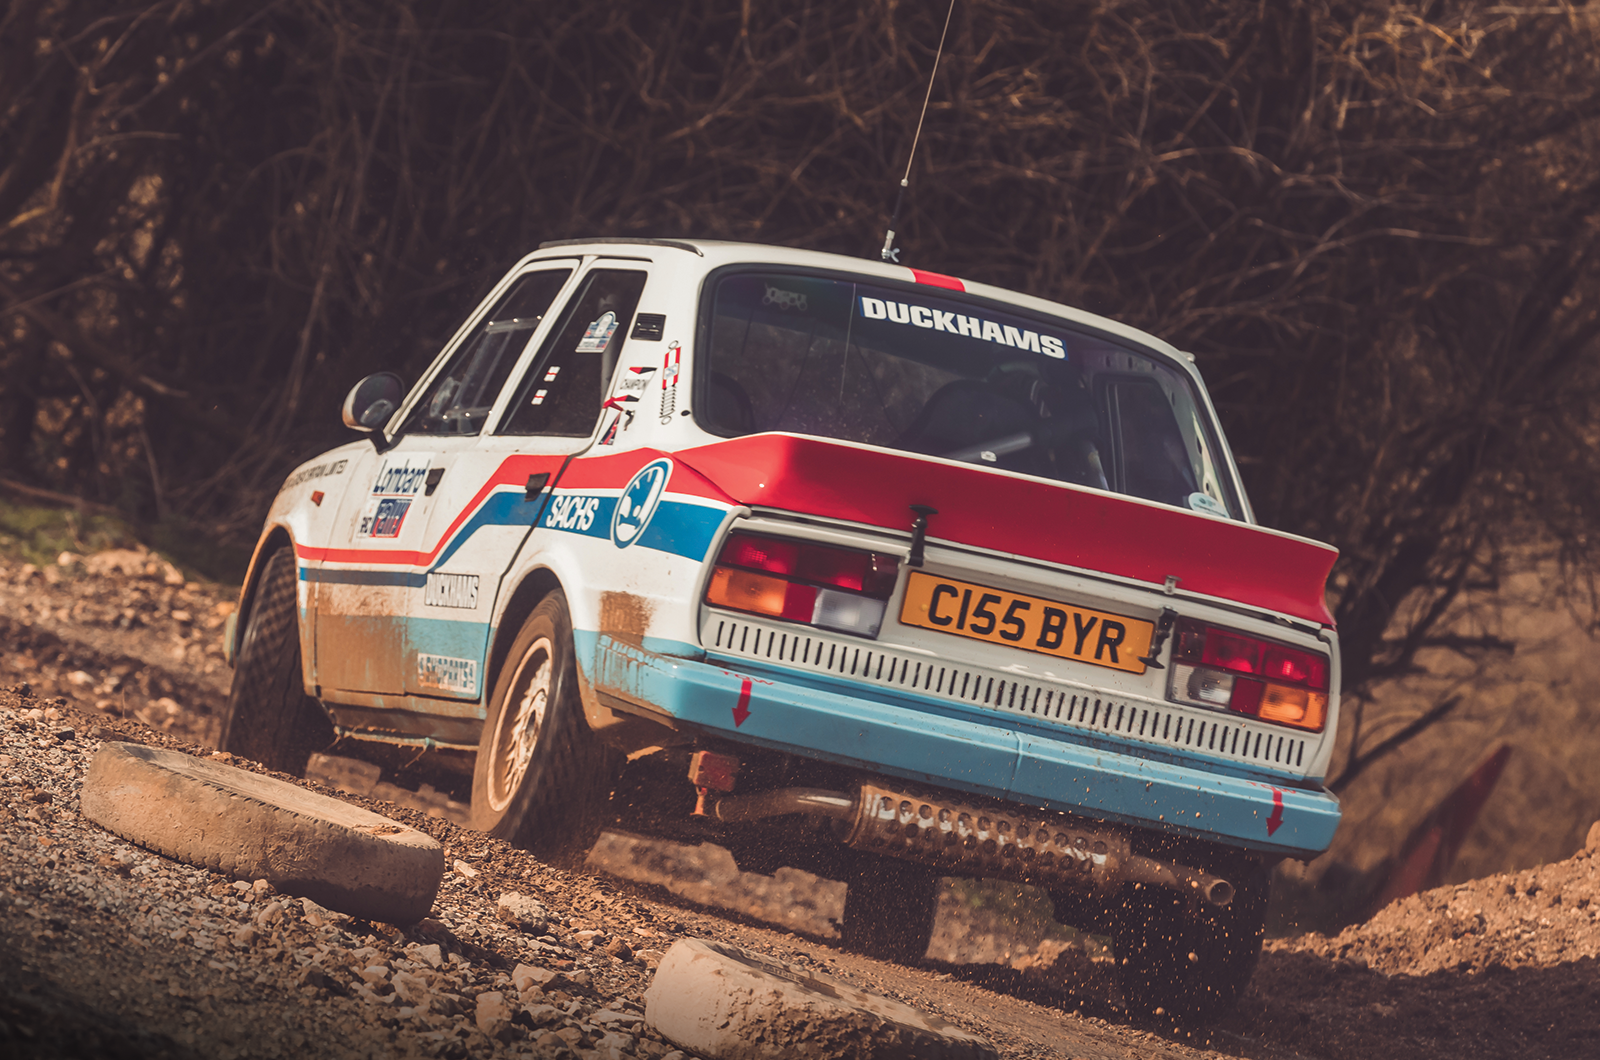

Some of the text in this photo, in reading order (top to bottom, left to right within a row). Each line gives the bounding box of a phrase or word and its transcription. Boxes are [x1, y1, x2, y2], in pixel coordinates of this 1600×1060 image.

[862, 296, 1066, 360] DUCKHAMS
[373, 459, 431, 493] Lombard
[545, 495, 600, 531] SACHS
[425, 573, 479, 608] DUCKHAMS
[927, 583, 1127, 664] C155 BYR
[719, 669, 774, 686] TOW
[1245, 780, 1297, 794] TOW
